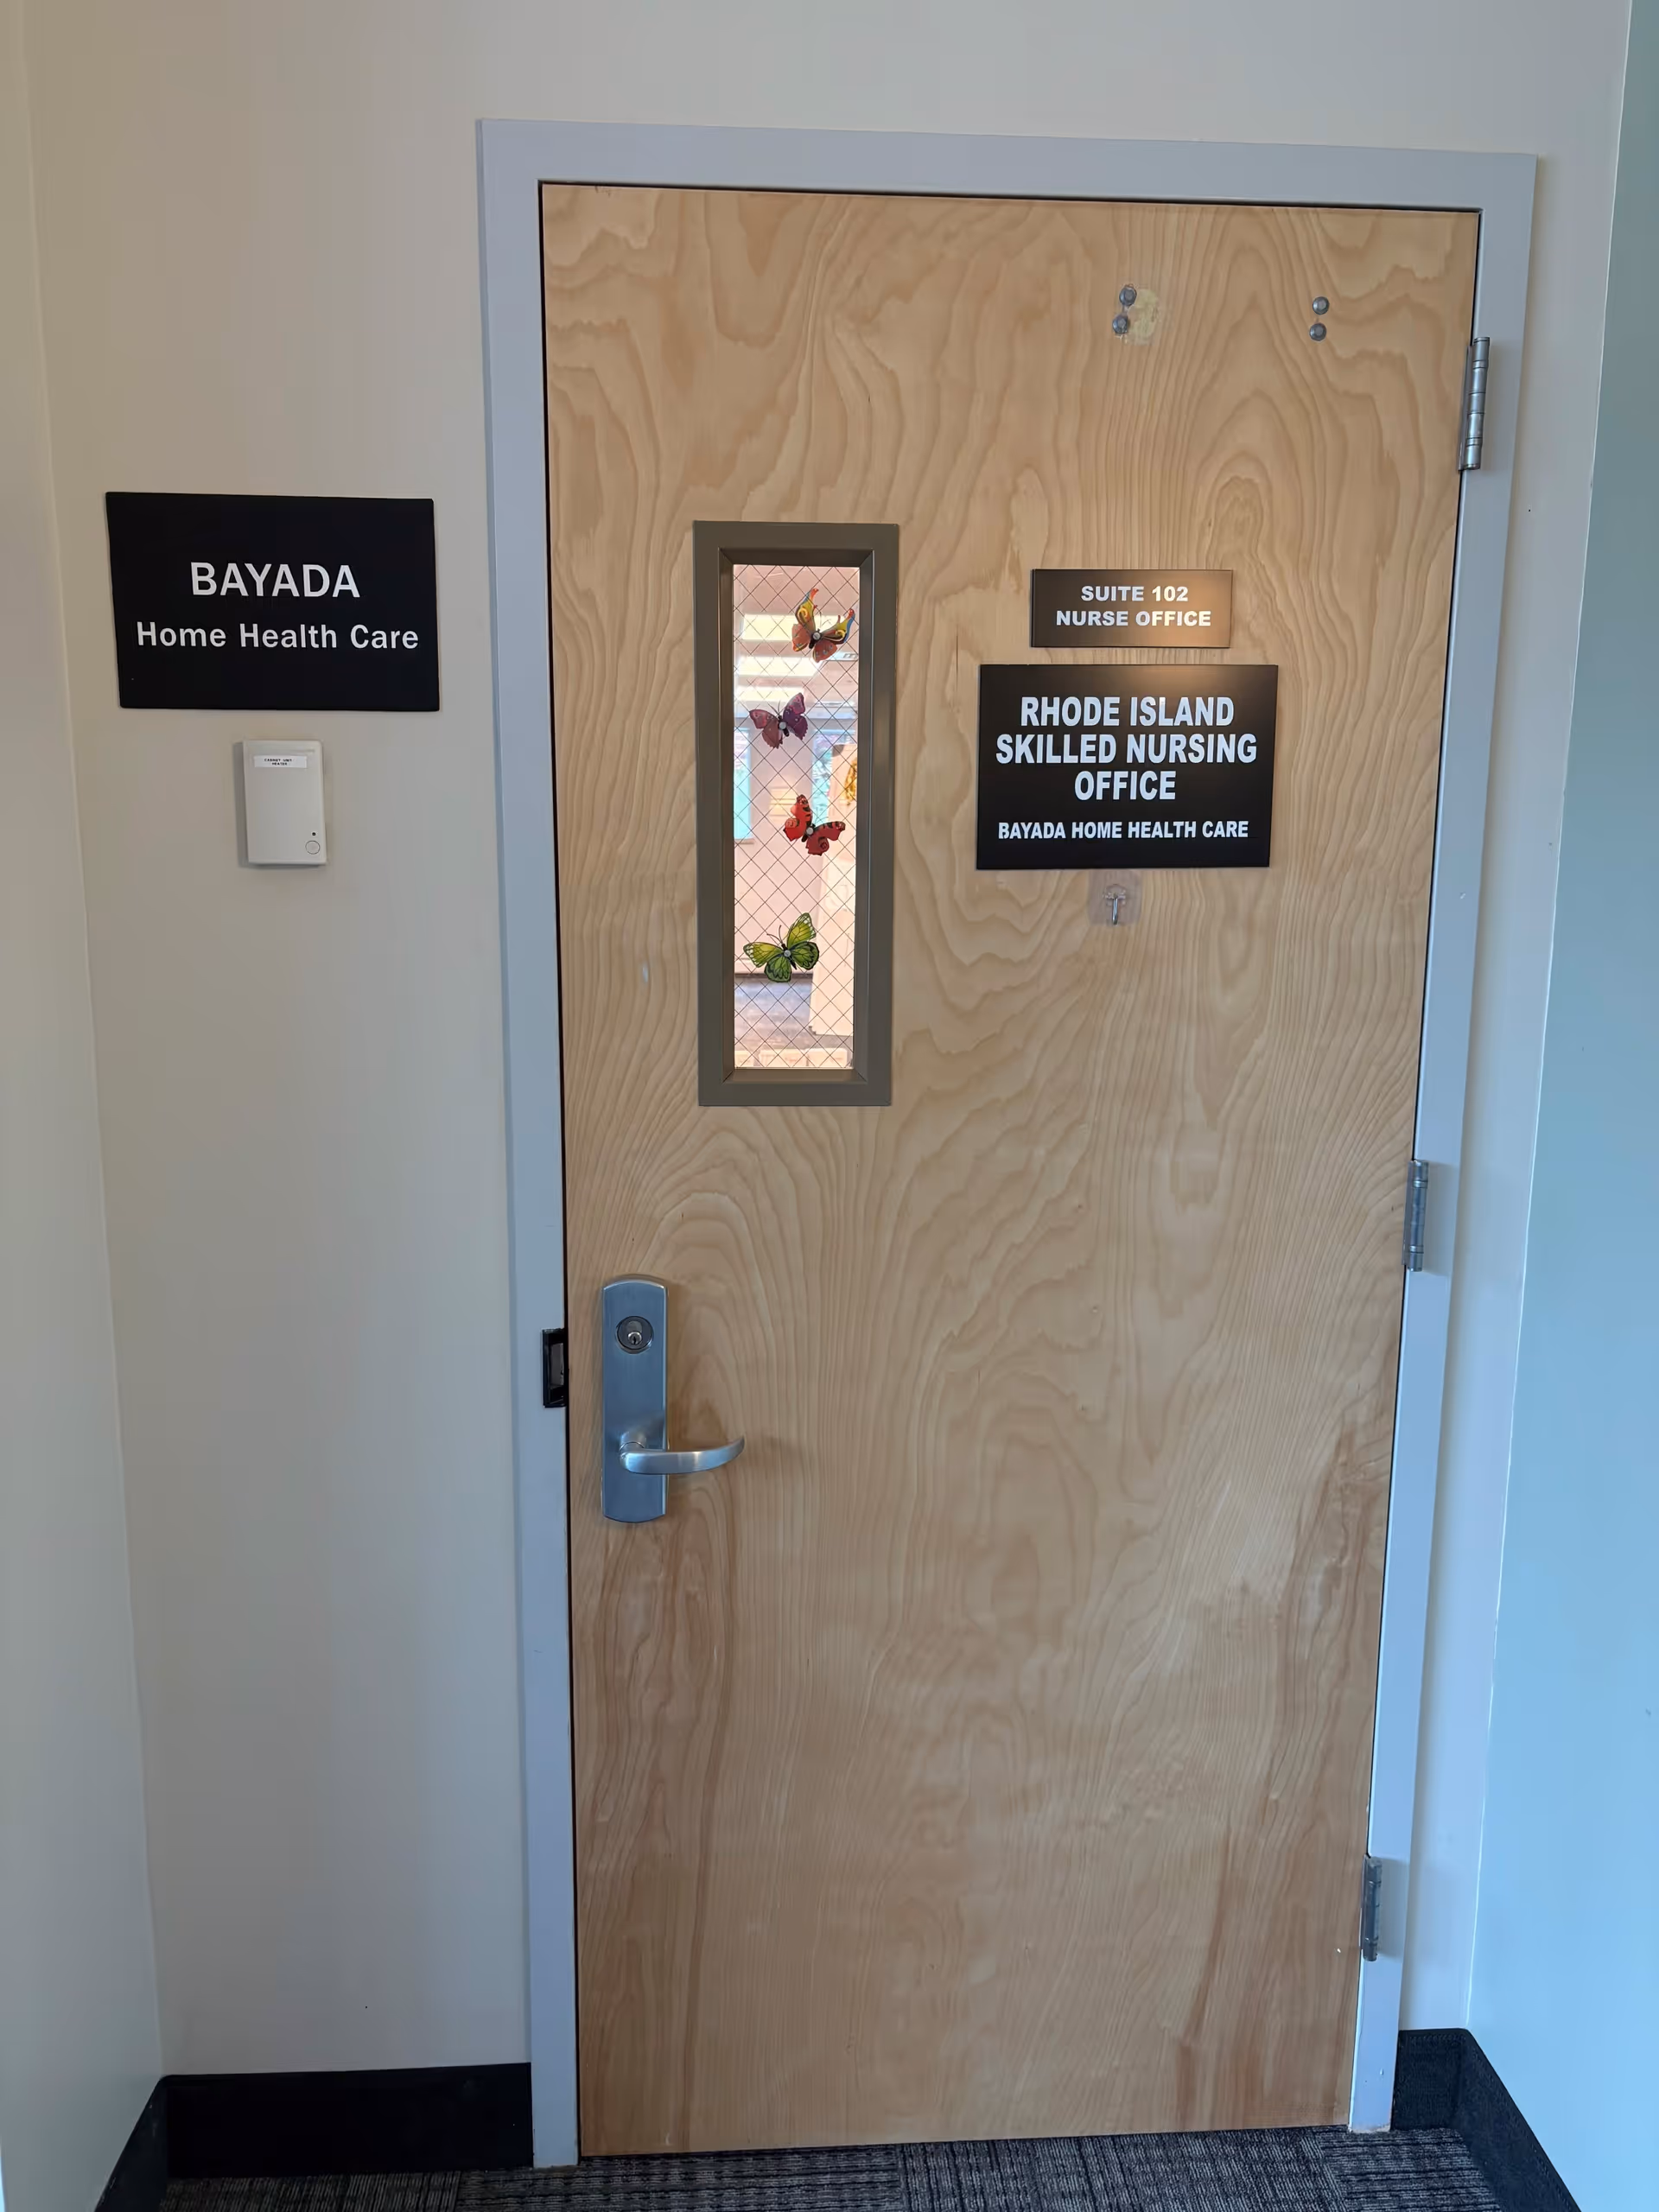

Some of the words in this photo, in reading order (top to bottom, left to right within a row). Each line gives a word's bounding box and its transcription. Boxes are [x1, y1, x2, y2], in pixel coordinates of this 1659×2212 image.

[190, 562, 361, 598] BAYADA
[1081, 585, 1145, 602] SUITE
[1151, 585, 1189, 602] 102
[1056, 610, 1128, 626] NURSE
[1135, 610, 1211, 627] OFFICE
[137, 621, 226, 647] Home
[239, 623, 337, 649] Health
[350, 625, 419, 650] Care
[1020, 696, 1122, 728] RHODE
[1128, 696, 1235, 727] ISLAND
[995, 733, 1116, 765] SKILLED
[1126, 733, 1257, 764] NURSING
[1074, 770, 1177, 801] OFFICE
[998, 822, 1066, 840] BAYADA
[1071, 821, 1122, 839] HOME
[1128, 821, 1197, 839] HEALTH
[1202, 820, 1249, 838] CARE
